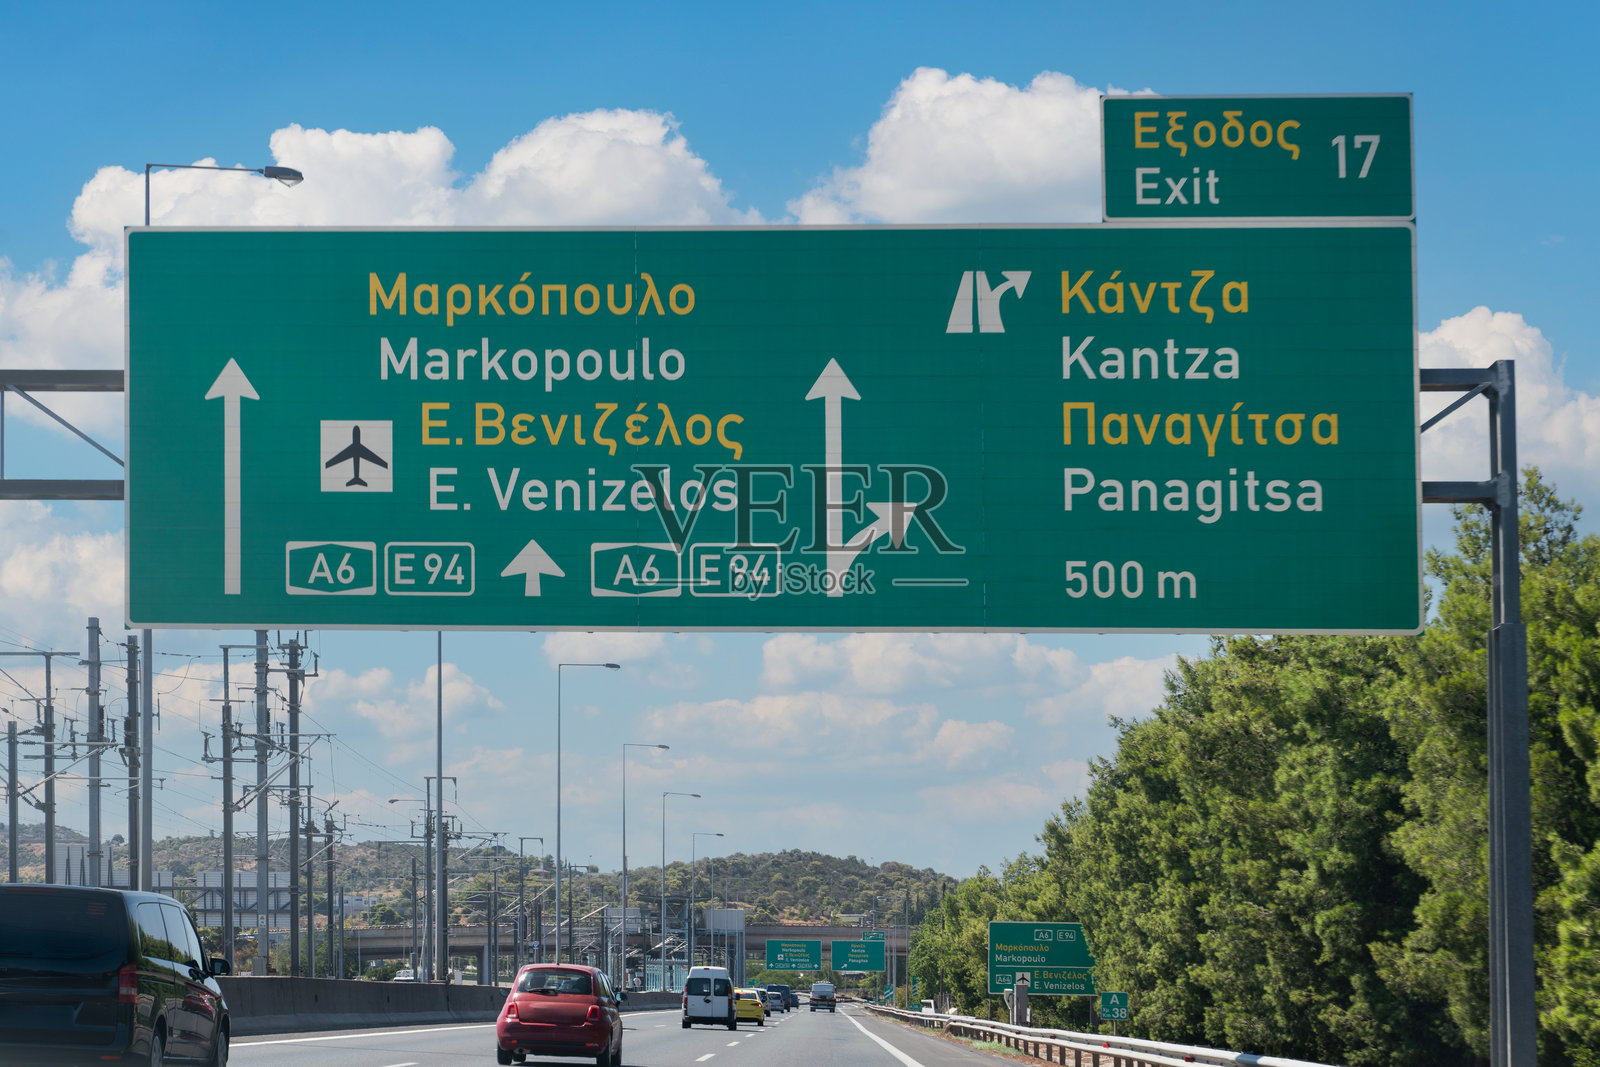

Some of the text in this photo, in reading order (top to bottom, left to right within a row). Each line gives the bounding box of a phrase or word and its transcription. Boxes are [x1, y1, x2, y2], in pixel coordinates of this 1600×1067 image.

[1135, 111, 1300, 160] Εξοδος
[1332, 135, 1379, 178] 17
[1136, 168, 1219, 204] Exit
[370, 272, 695, 326] Μαρκόπουλο
[1062, 270, 1248, 323] Κάντζα
[381, 338, 685, 392] Markopoulo
[1063, 336, 1239, 379] Kantza
[1064, 402, 1338, 457] Παναγίτσα
[430, 467, 738, 511] E. Venizelos
[1064, 468, 1322, 523] Panagitsa
[308, 553, 464, 584] A6 E 94
[613, 554, 661, 586] A6
[700, 555, 721, 585] E
[1066, 561, 1196, 598] 500 m
[996, 944, 1049, 952] Μαρκόπουλο
[1038, 931, 1049, 939] A6
[996, 954, 1046, 964] Markopoulo
[1044, 982, 1085, 990] Venizelos
[1111, 1007, 1127, 1018] 38
